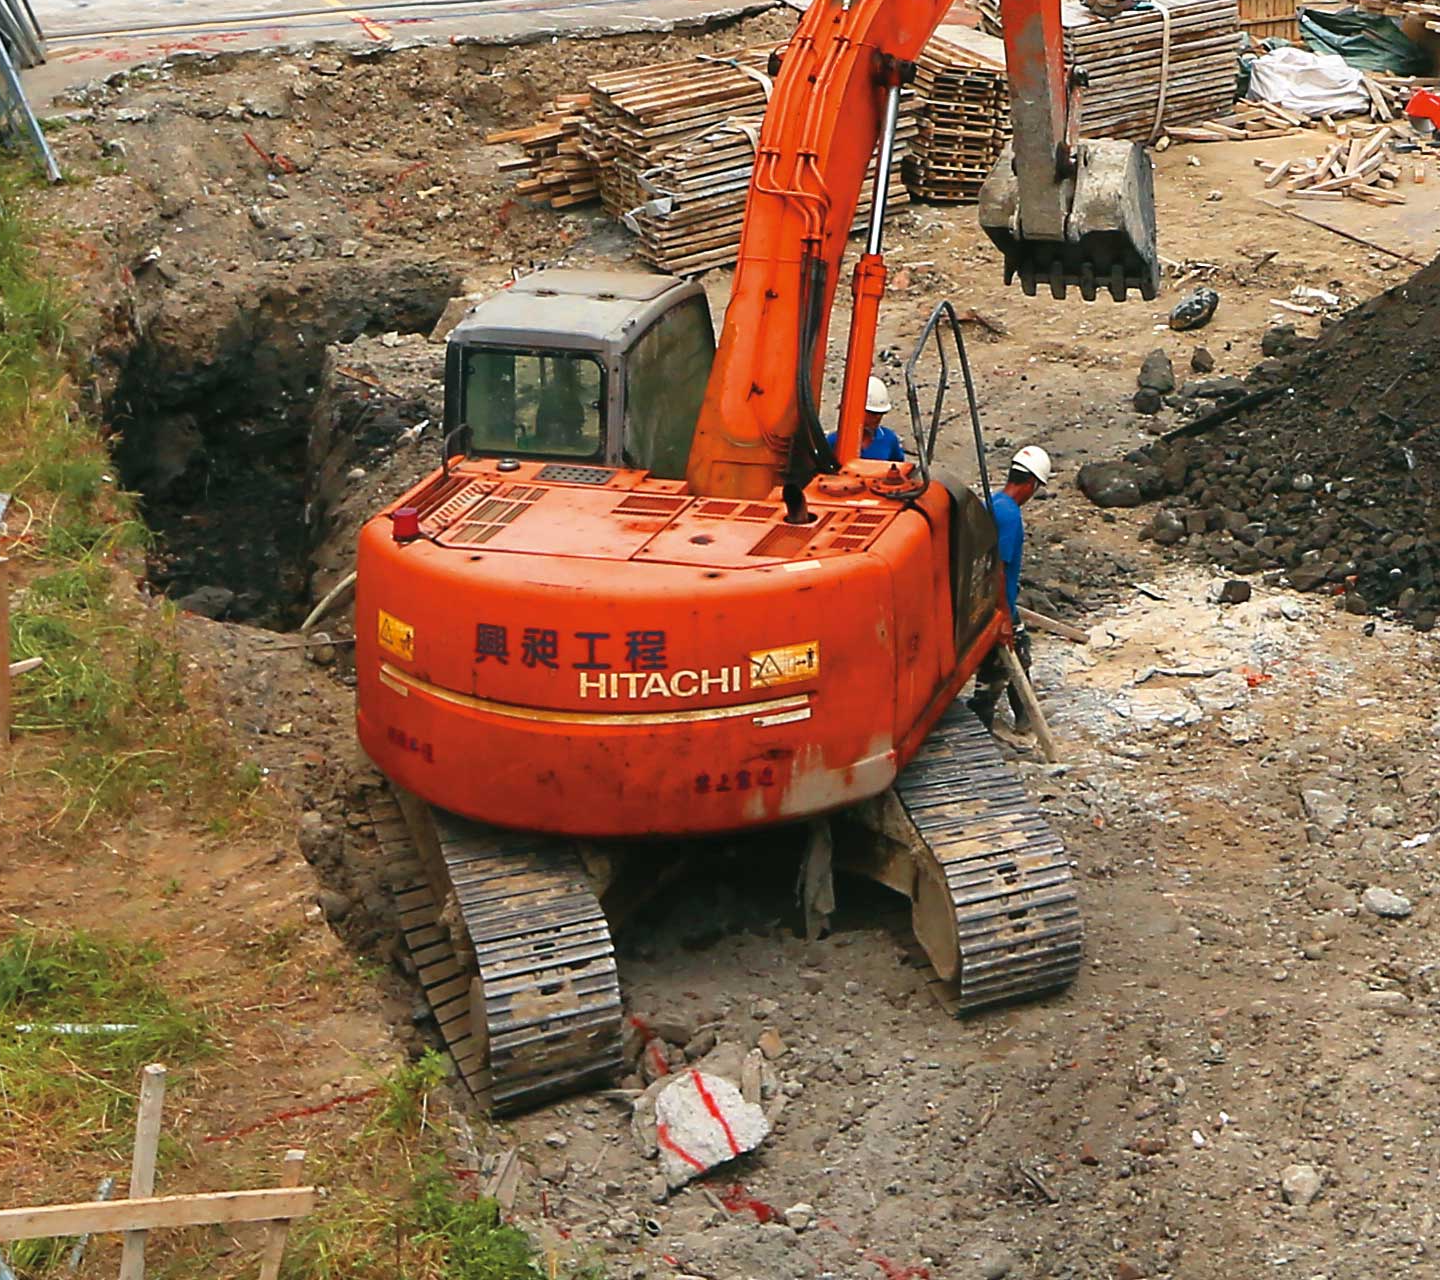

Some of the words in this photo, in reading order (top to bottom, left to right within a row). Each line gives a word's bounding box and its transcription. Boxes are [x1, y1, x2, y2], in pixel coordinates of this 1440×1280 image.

[475, 623, 667, 671] 興昶工程
[578, 666, 741, 698] HITACHI
